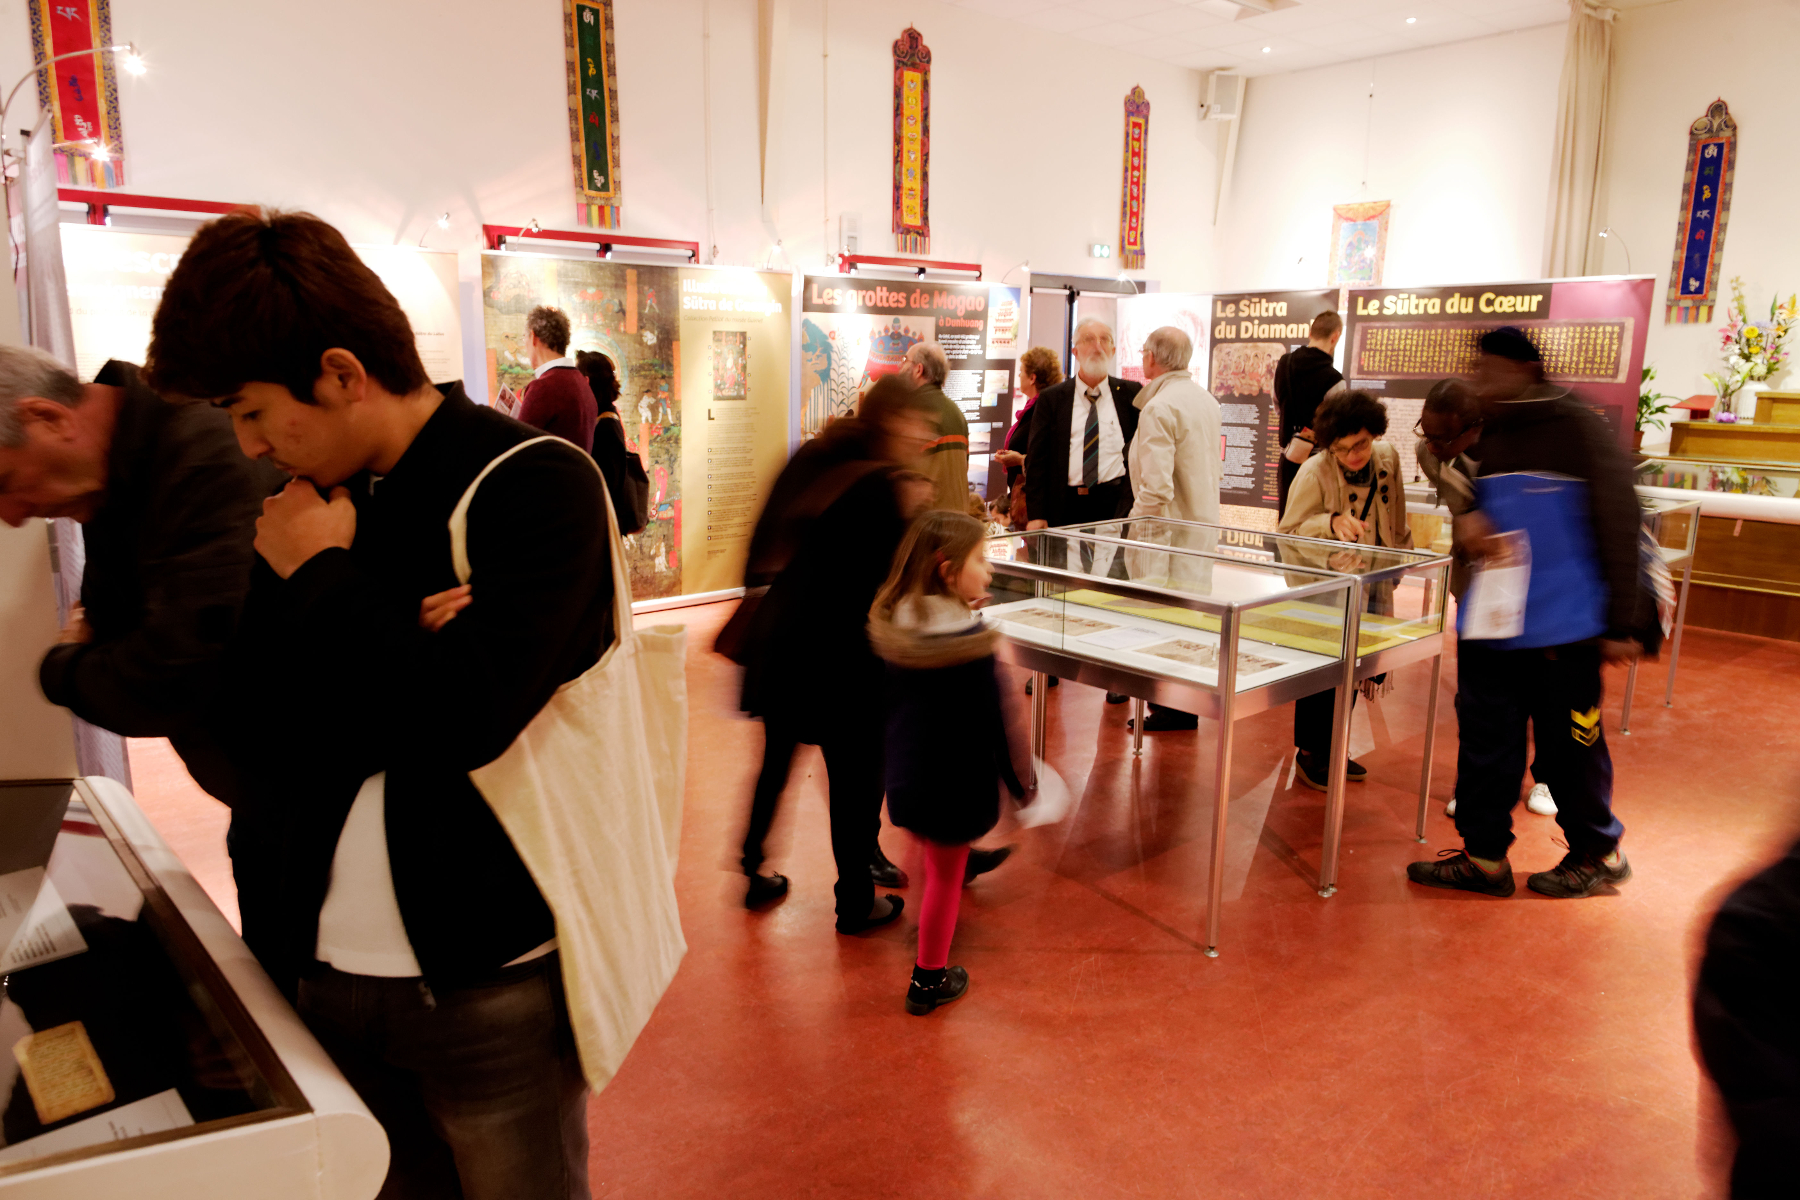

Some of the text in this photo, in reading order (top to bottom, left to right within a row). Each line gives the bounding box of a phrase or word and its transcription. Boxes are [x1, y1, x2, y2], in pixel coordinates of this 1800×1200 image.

[718, 297, 733, 311] de
[812, 283, 985, 317] Les grottes de Mogao
[1216, 297, 1287, 318] Le Sūtra
[1356, 291, 1544, 316] Le Sūtra du Cœur
[938, 315, 984, 331] à Dunhuang
[1214, 319, 1315, 339] du Diaman
